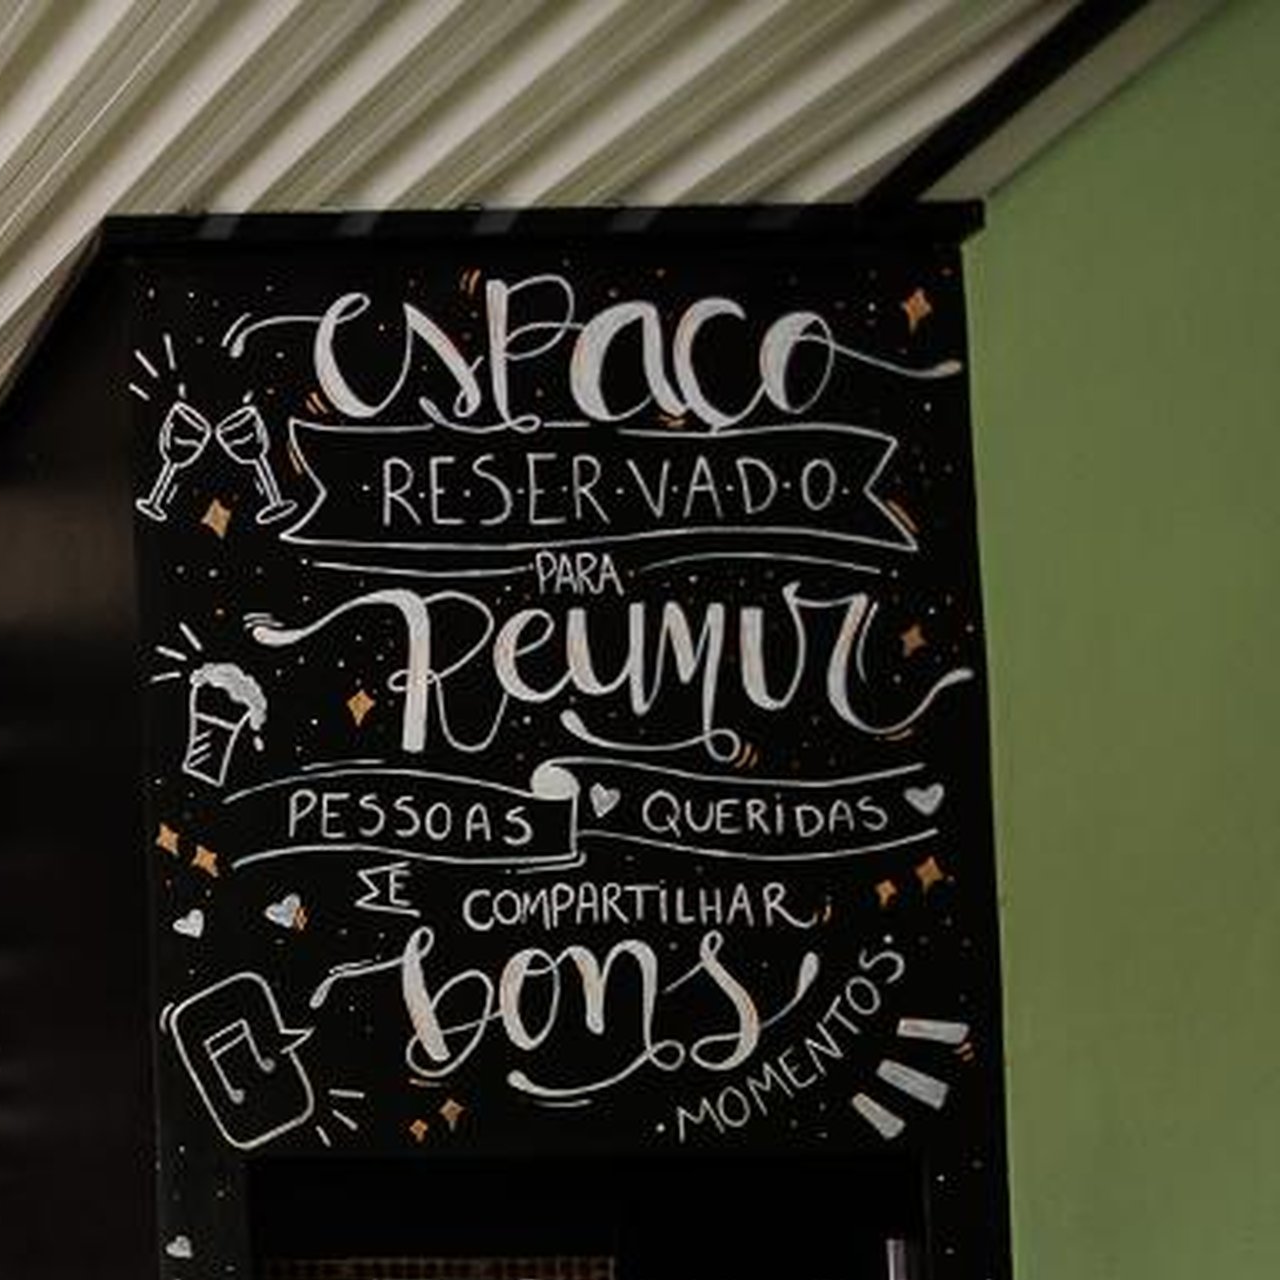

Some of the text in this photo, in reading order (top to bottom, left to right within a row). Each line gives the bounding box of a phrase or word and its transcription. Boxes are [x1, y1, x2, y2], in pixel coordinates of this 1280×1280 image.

[536, 550, 625, 597] PARA
[288, 789, 889, 846] PESSOAS QUERIDAS
[461, 882, 818, 931] COMPARTILHAR
[677, 950, 906, 1142] MOMENTOS
